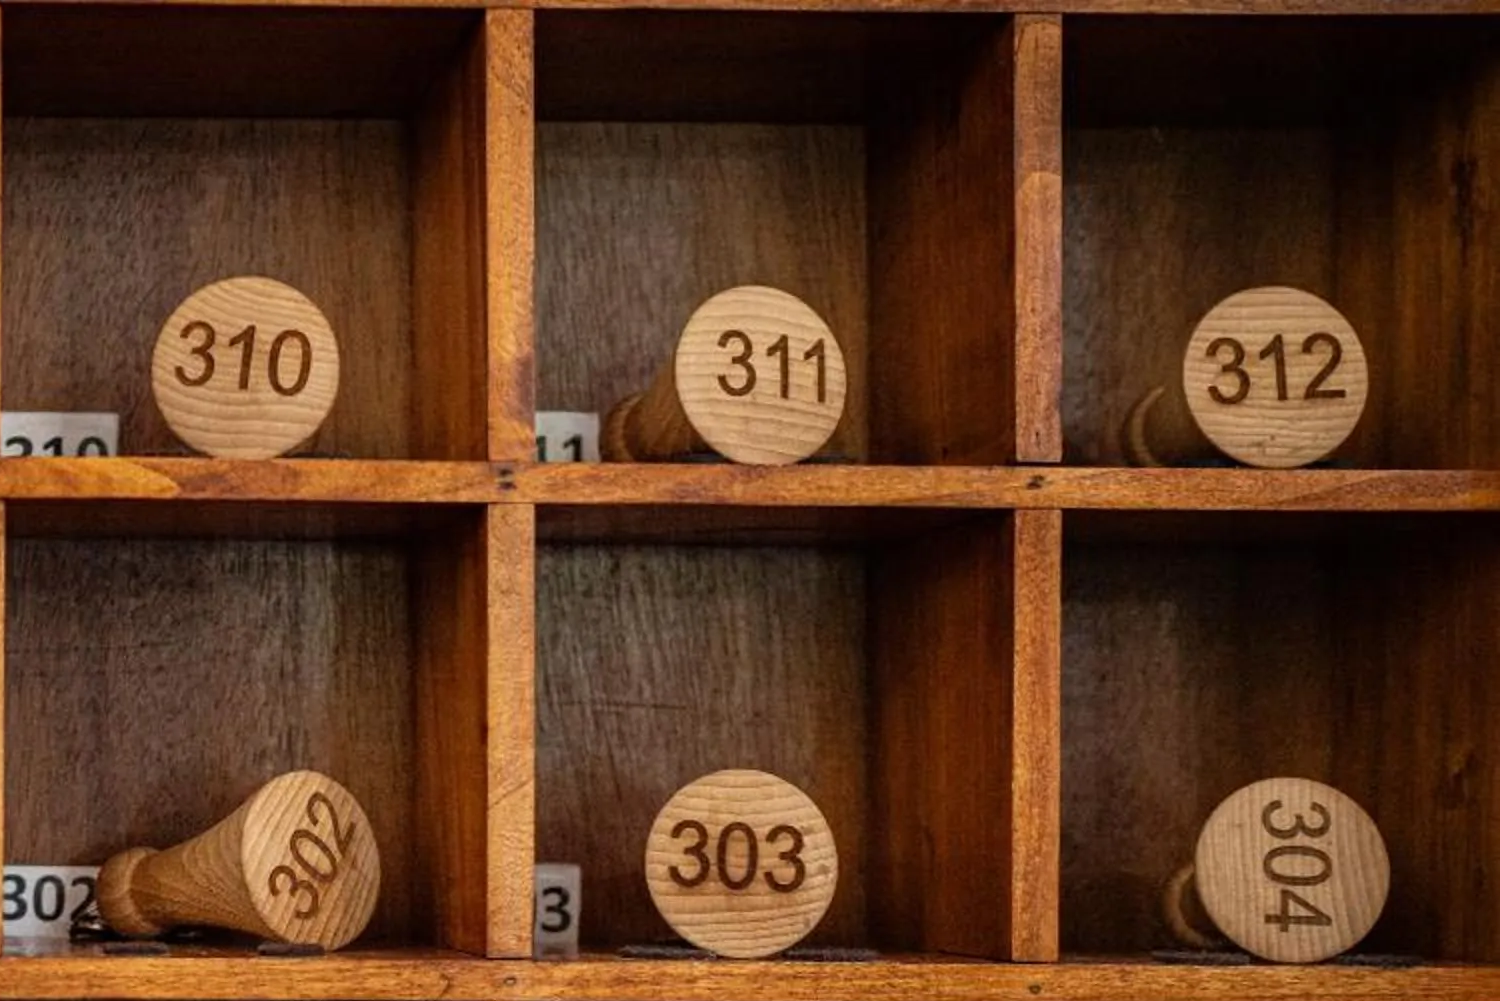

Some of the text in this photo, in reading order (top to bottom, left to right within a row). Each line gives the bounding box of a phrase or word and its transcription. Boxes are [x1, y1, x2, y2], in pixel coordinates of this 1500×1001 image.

[174, 321, 312, 396] 310
[717, 330, 826, 403] 311
[1205, 332, 1346, 404] 312
[536, 434, 583, 461] 11
[268, 791, 356, 920] 302
[667, 820, 806, 893] 303
[1262, 800, 1332, 932] 304
[2, 874, 97, 922] 302
